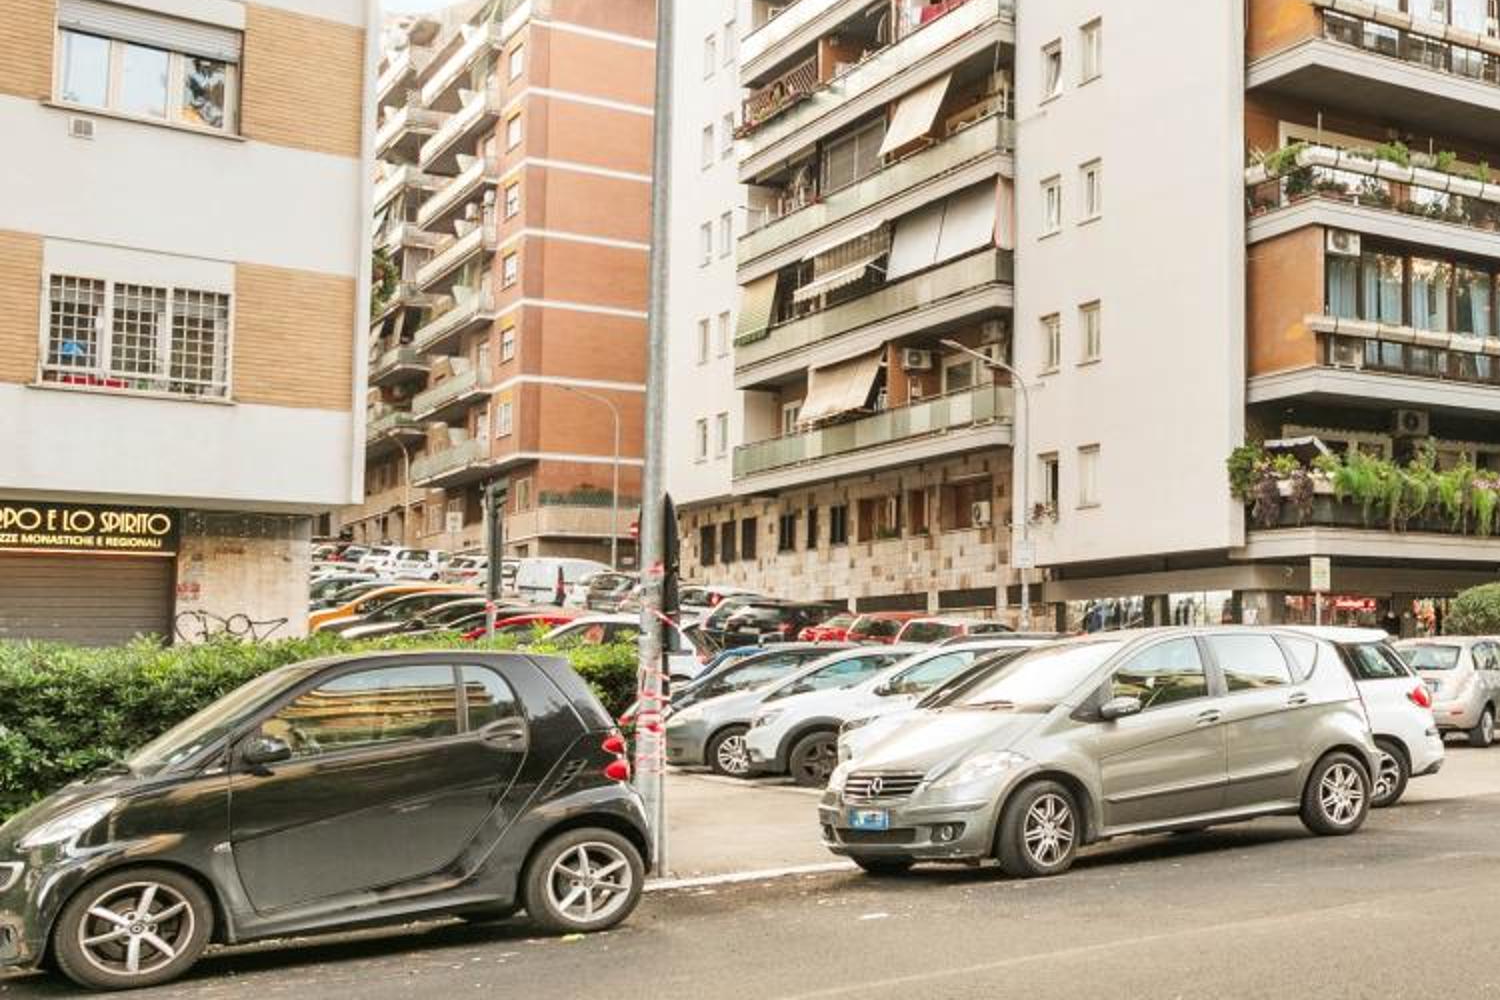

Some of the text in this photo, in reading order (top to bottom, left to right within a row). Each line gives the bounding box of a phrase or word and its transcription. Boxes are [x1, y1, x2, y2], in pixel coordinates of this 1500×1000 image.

[47, 510, 57, 531] E
[63, 510, 95, 532] LO
[100, 511, 171, 535] SPIRITO
[21, 533, 94, 546] MONASTICHE
[106, 537, 162, 548] REGIONALI
